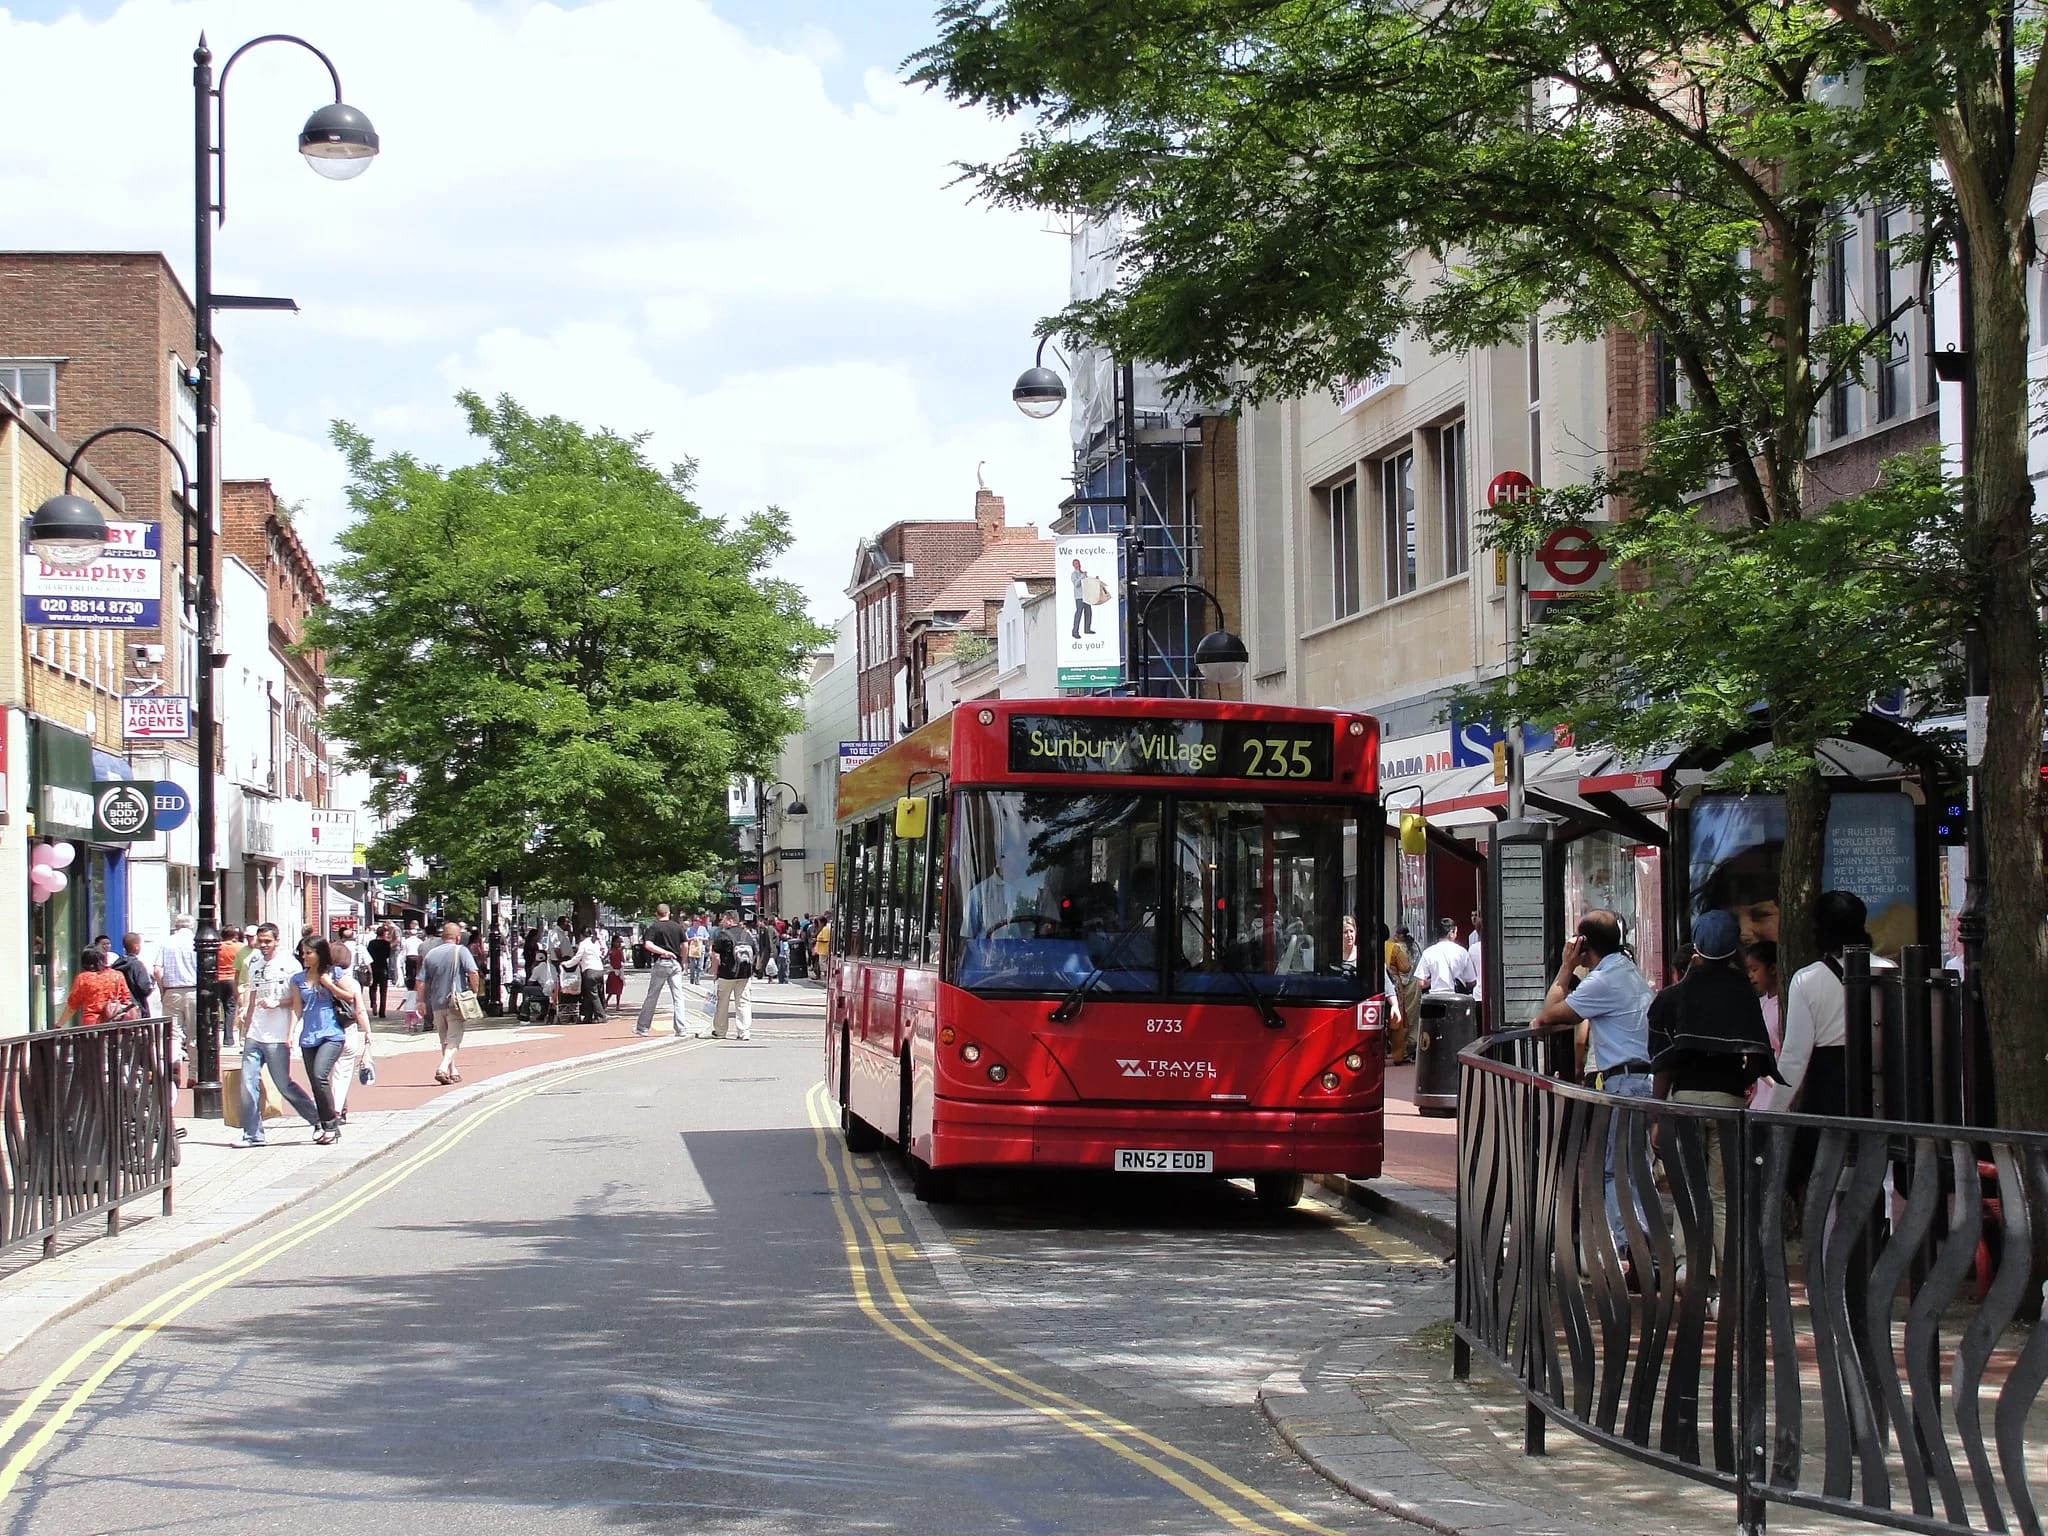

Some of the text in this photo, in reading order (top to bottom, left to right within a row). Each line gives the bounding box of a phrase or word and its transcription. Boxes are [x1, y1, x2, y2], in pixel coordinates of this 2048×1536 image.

[1058, 546, 1073, 556] We
[41, 599, 144, 615] 020 8814 8730
[1072, 641, 1105, 652] do you?
[130, 704, 183, 715] TRAVEL
[128, 717, 184, 727] AGENTS
[1030, 731, 1313, 777] Sunbury Village 235
[115, 801, 133, 809] THE
[155, 795, 184, 810] EED
[109, 809, 139, 817] BODY
[110, 817, 138, 826] SHOP
[1847, 827, 1876, 837] RULED
[1880, 827, 1896, 836] THE
[1832, 837, 1894, 847] WORLD EVERY
[1833, 847, 1850, 856] DAY
[1852, 846, 1884, 856] WOULD
[1146, 1019, 1183, 1033] 8733
[1147, 1060, 1217, 1072] TRAVEL
[1146, 1070, 1217, 1079] LONDON
[1121, 1152, 1206, 1169] RN52 EOB
